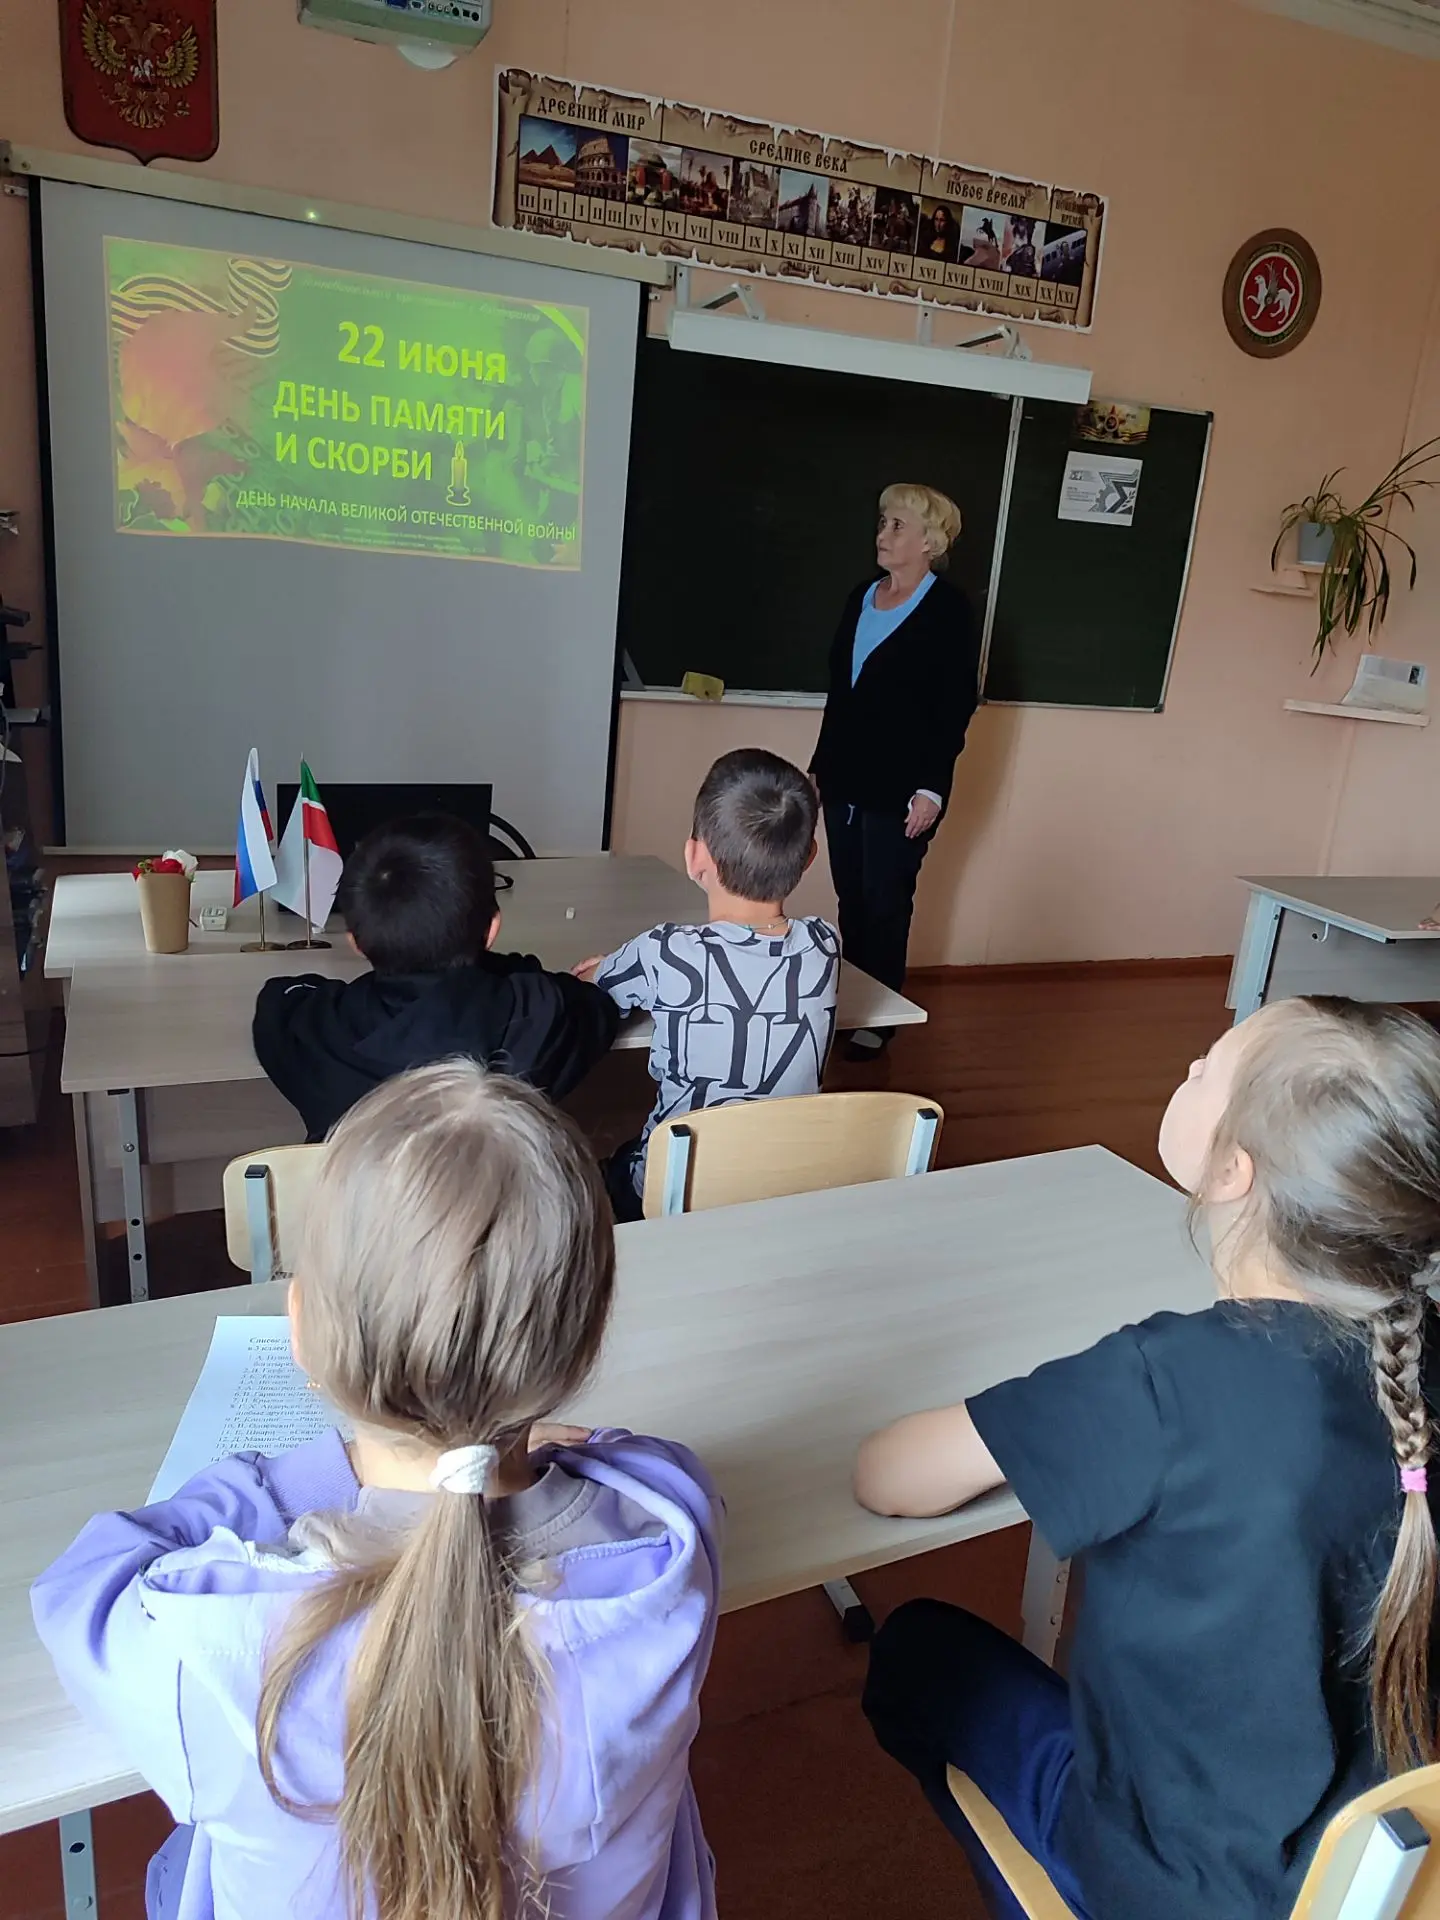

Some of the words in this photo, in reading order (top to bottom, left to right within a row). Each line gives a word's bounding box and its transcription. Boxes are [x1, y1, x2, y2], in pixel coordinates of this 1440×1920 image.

[537, 96, 608, 124] ДРЕВНИЙ
[612, 113, 645, 131] МИР
[750, 139, 811, 165] СРЕДНИЕ
[815, 153, 848, 174] ВЕКА
[946, 179, 984, 202] НОВОЕ
[986, 188, 1027, 210] ВРЕМЯ
[520, 194, 535, 208] III
[543, 198, 552, 211] II
[593, 207, 602, 220] II
[608, 210, 622, 224] III
[629, 213, 642, 226] IV
[651, 217, 660, 229] V
[667, 220, 679, 235] VI
[690, 224, 708, 240] VII
[717, 229, 739, 245] VIII
[748, 234, 762, 249] IX
[770, 238, 779, 252] X
[787, 242, 800, 255] XI
[809, 246, 825, 260] XII
[835, 251, 855, 265] XIII
[866, 256, 885, 269] XIV
[893, 261, 908, 273] XV
[919, 266, 937, 280] XVI
[947, 269, 968, 286] XVII
[979, 273, 1003, 292] XVIII
[1015, 283, 1031, 297] XIX
[1040, 286, 1053, 301] XX
[1057, 290, 1074, 304] XXI
[338, 321, 385, 367] 22
[400, 339, 506, 384] ИЮНЯ
[273, 381, 360, 424] ДЕНЬ
[371, 395, 506, 440] ПАМЯТИ
[275, 431, 297, 464] И
[307, 436, 432, 481] СКОРБИ
[236, 491, 276, 510] ДЕНЬ
[281, 494, 337, 516] НАЧАЛА
[341, 499, 408, 523] ВЕЛИКОЙ
[411, 507, 523, 537] ОТЕЧЕСТВЕННОЙ
[527, 519, 577, 541] ВОЙНЫ
